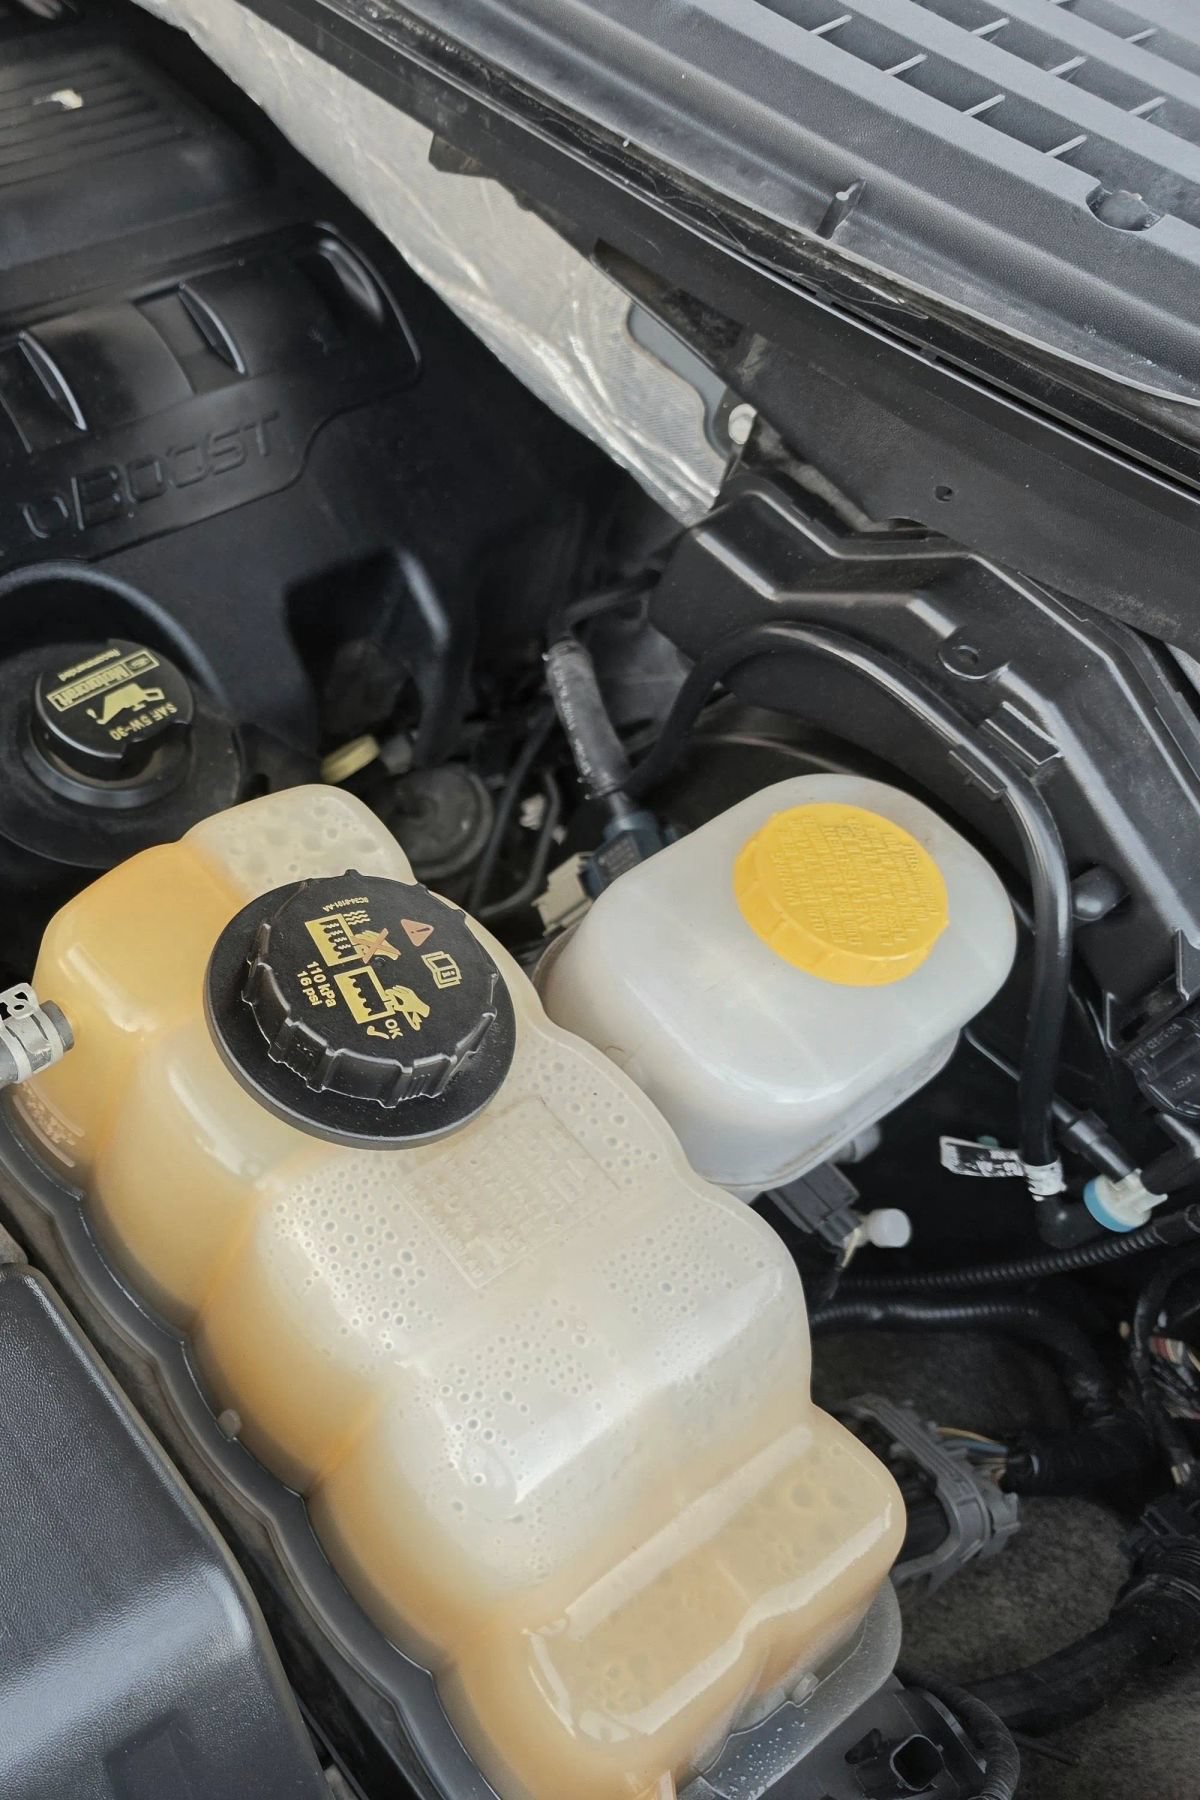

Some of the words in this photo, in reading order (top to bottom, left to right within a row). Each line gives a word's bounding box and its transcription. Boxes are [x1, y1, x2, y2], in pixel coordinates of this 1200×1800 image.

[52, 664, 131, 706] Motorcraft
[109, 715, 153, 741] 5W-30
[297, 970, 313, 987] 16
[306, 961, 327, 985] 110
[317, 983, 337, 1008] kPa
[302, 986, 323, 1006] psi
[384, 1018, 404, 1039] OK
